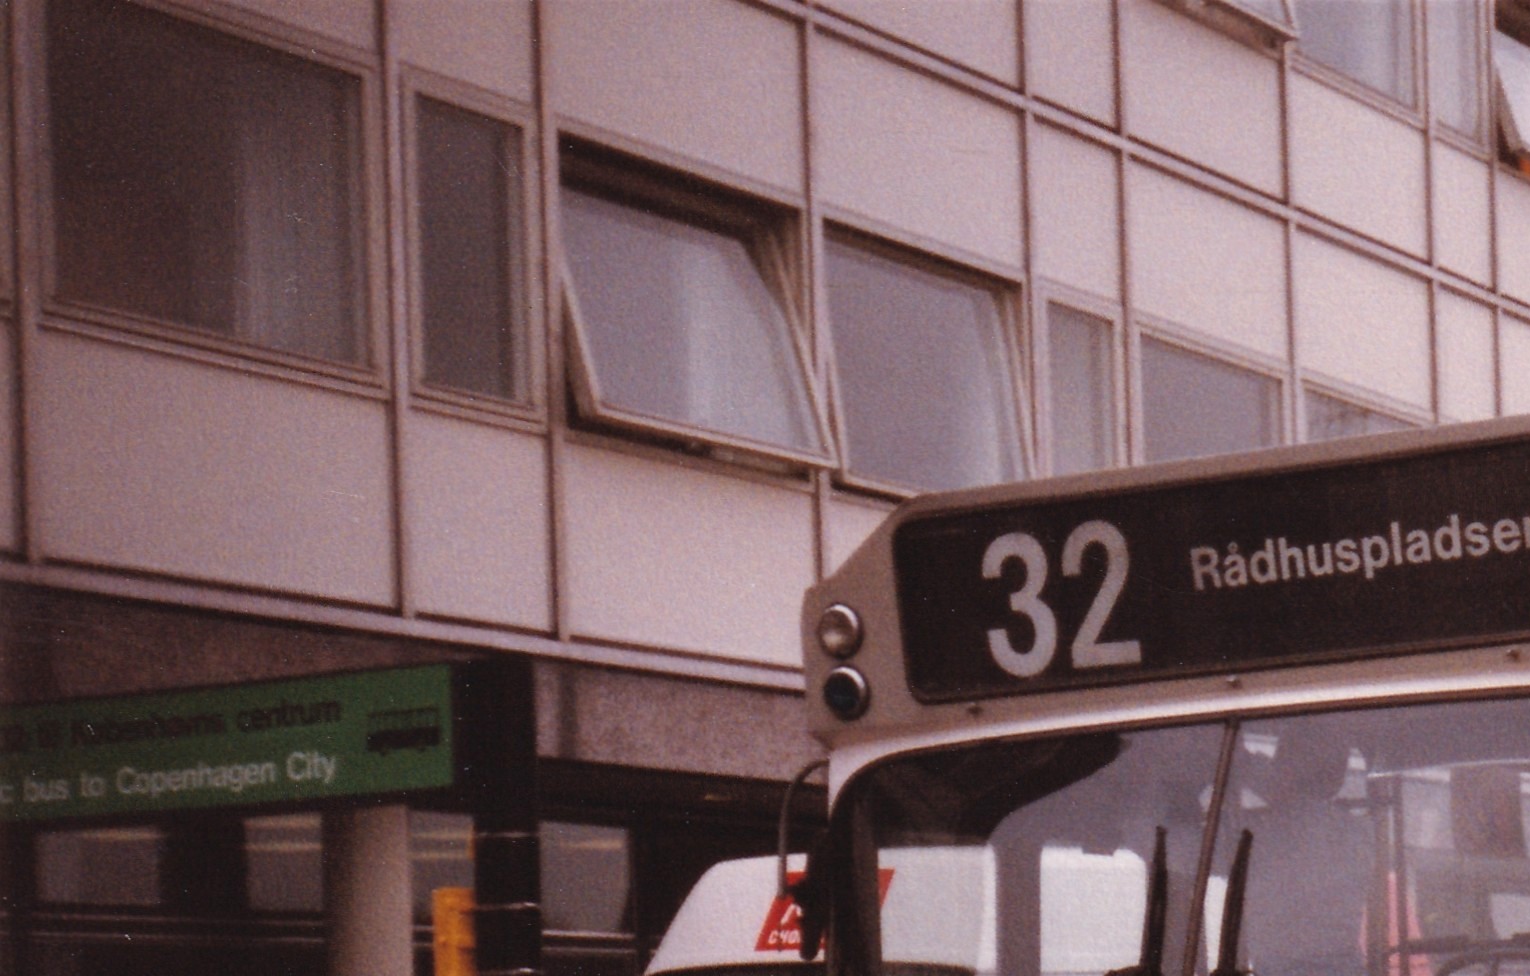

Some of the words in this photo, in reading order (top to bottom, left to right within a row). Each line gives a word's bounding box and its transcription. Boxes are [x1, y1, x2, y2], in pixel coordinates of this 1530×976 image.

[982, 520, 1141, 678] 32
[236, 702, 342, 731] centrum
[24, 774, 70, 800] bus
[80, 770, 106, 798] to
[116, 760, 276, 796] Copenhagen
[285, 750, 337, 782] City
